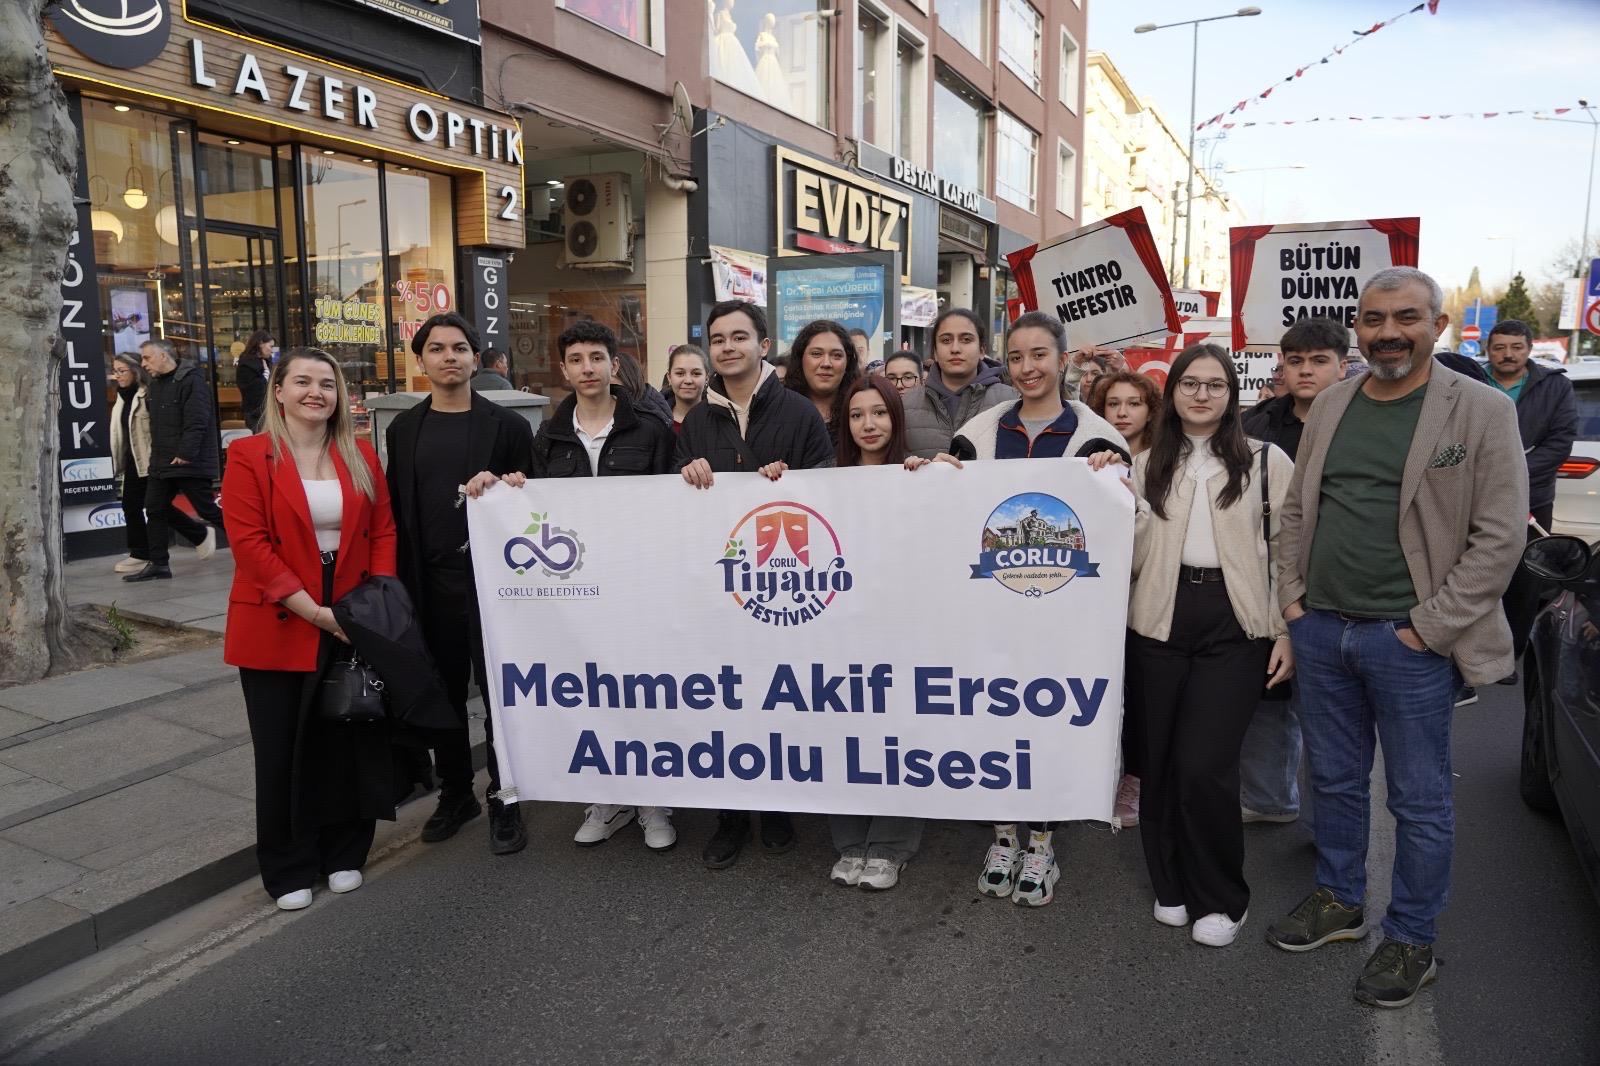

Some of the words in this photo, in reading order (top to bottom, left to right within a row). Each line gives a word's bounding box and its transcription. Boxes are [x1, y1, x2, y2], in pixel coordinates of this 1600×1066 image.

[188, 38, 379, 130] LAZER
[893, 156, 939, 198] DESTAN
[943, 179, 980, 214] KAFTAN
[499, 185, 518, 221] 2
[1280, 241, 1361, 271] BÜTÜN
[1051, 260, 1122, 298] TİYATRO
[1281, 271, 1359, 300] DÜNYA
[315, 295, 342, 319] TÜM
[396, 280, 451, 313] %50
[483, 266, 500, 348] GÖZ
[1056, 283, 1138, 324] NEFESTİR
[62, 230, 97, 450] ÖZLÜK
[316, 319, 380, 344] GÖZLÜKLERİNDE
[64, 485, 90, 494] REÇETE
[91, 484, 114, 492] YAPILIR
[68, 467, 99, 481] SGK
[769, 557, 797, 571] ÇORLU
[995, 548, 1072, 568] ÇORLU
[498, 587, 533, 598] ÇORLU
[536, 585, 600, 597] BELEDİYESİ
[714, 549, 853, 604] Tiyatro
[742, 594, 827, 627] FESTİVALİ
[502, 662, 743, 710] Mehmet
[761, 663, 893, 714] Akif
[914, 666, 1110, 728] Ersoy
[568, 729, 823, 783] Anadolu
[846, 736, 1032, 791] Lisesi
